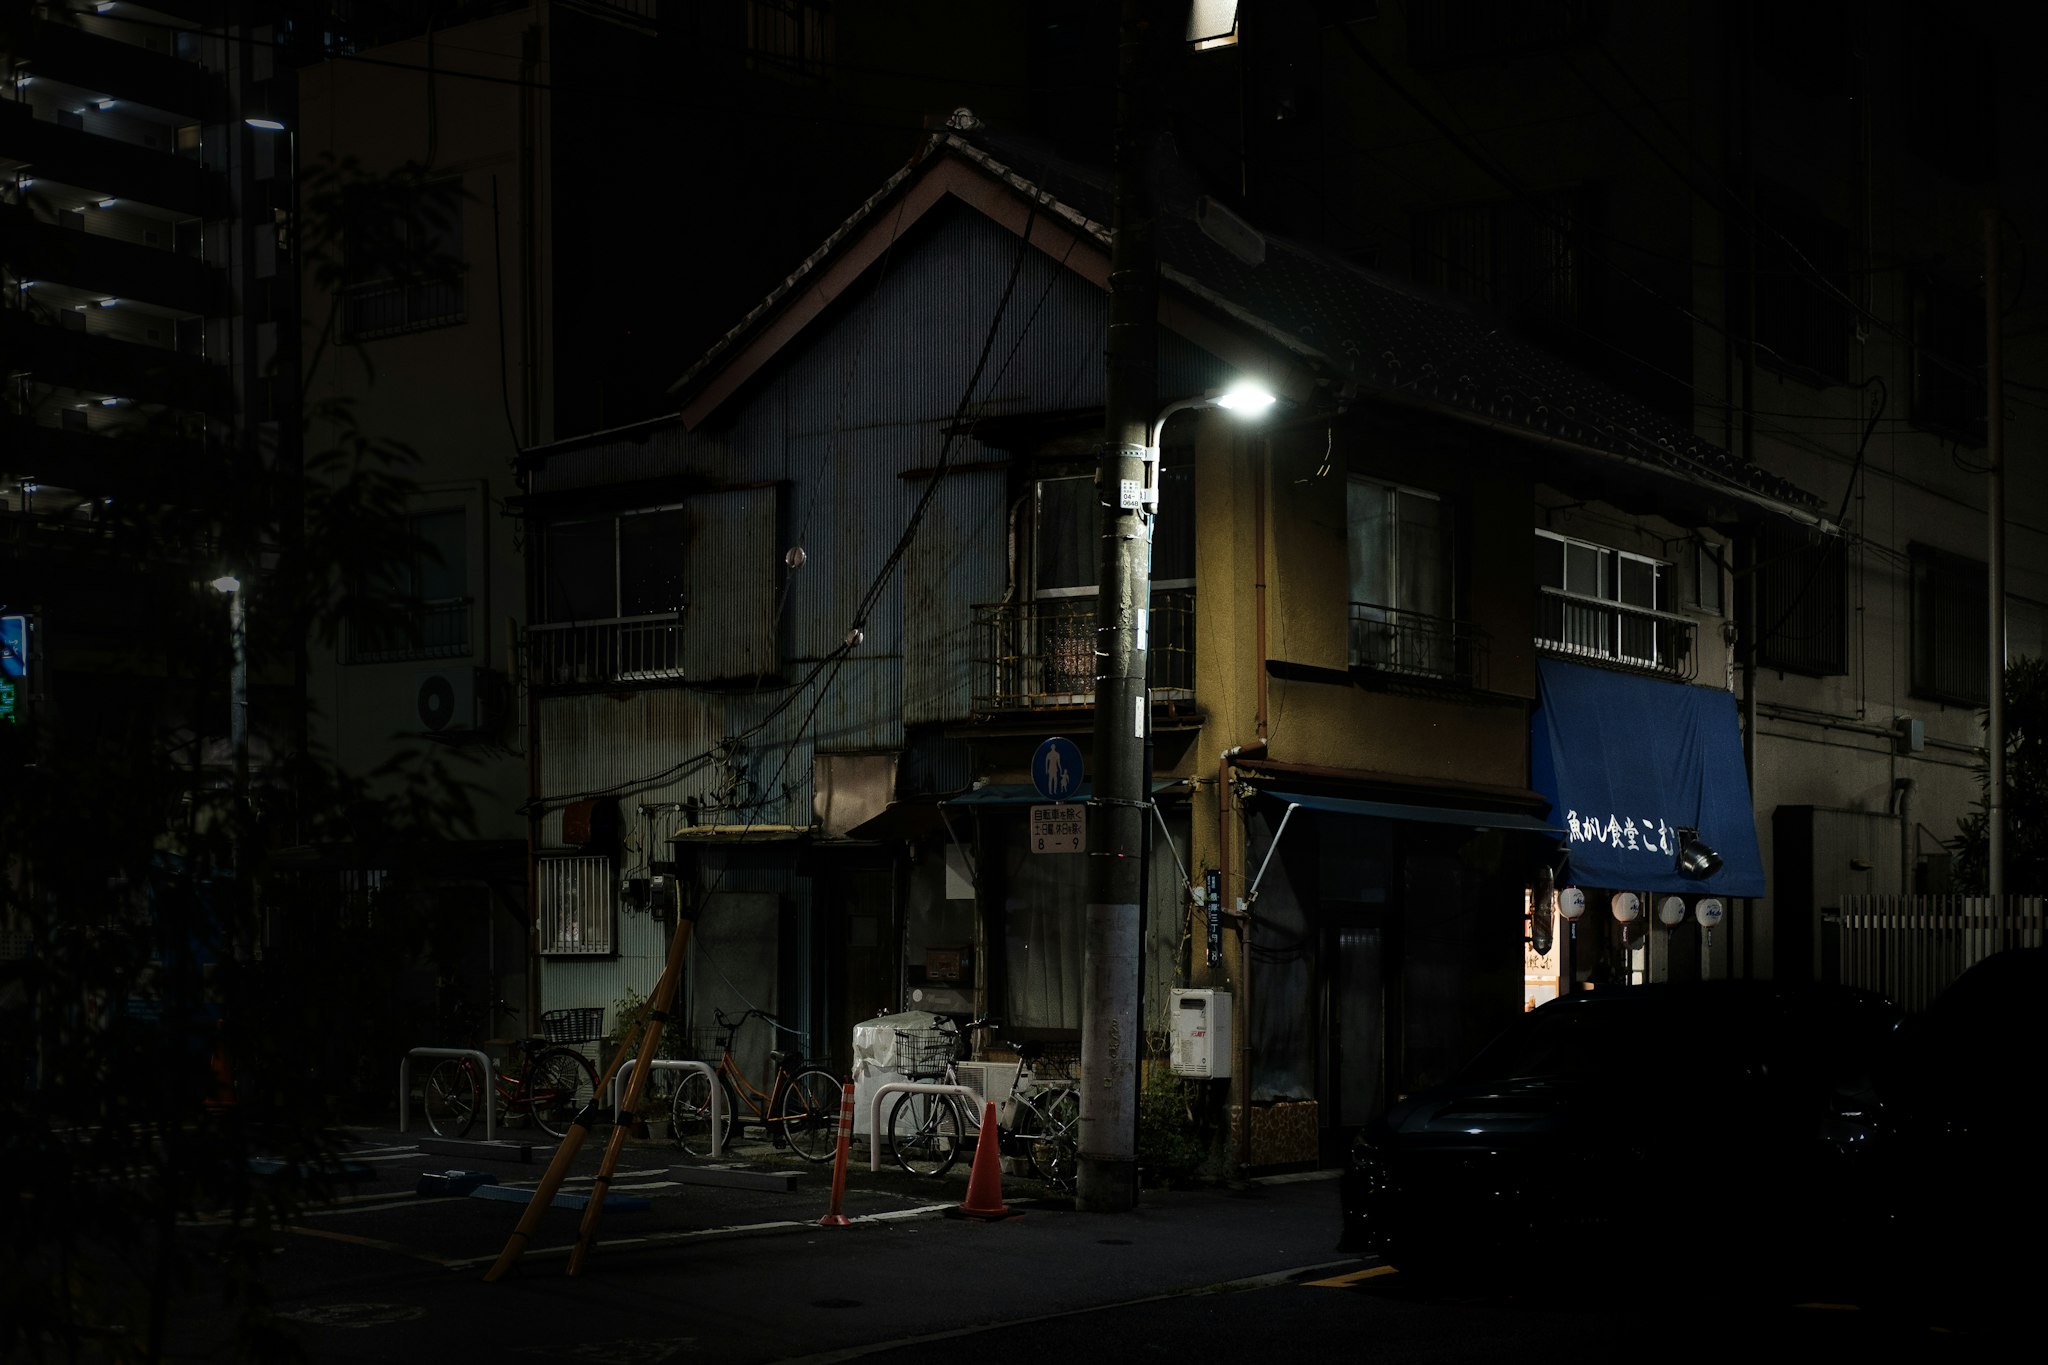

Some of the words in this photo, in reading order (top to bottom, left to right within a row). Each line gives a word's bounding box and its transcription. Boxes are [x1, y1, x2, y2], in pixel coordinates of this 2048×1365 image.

[1034, 808, 1082, 821] 自転車を除く
[1038, 838, 1045, 850] 8
[1072, 837, 1079, 849] 9
